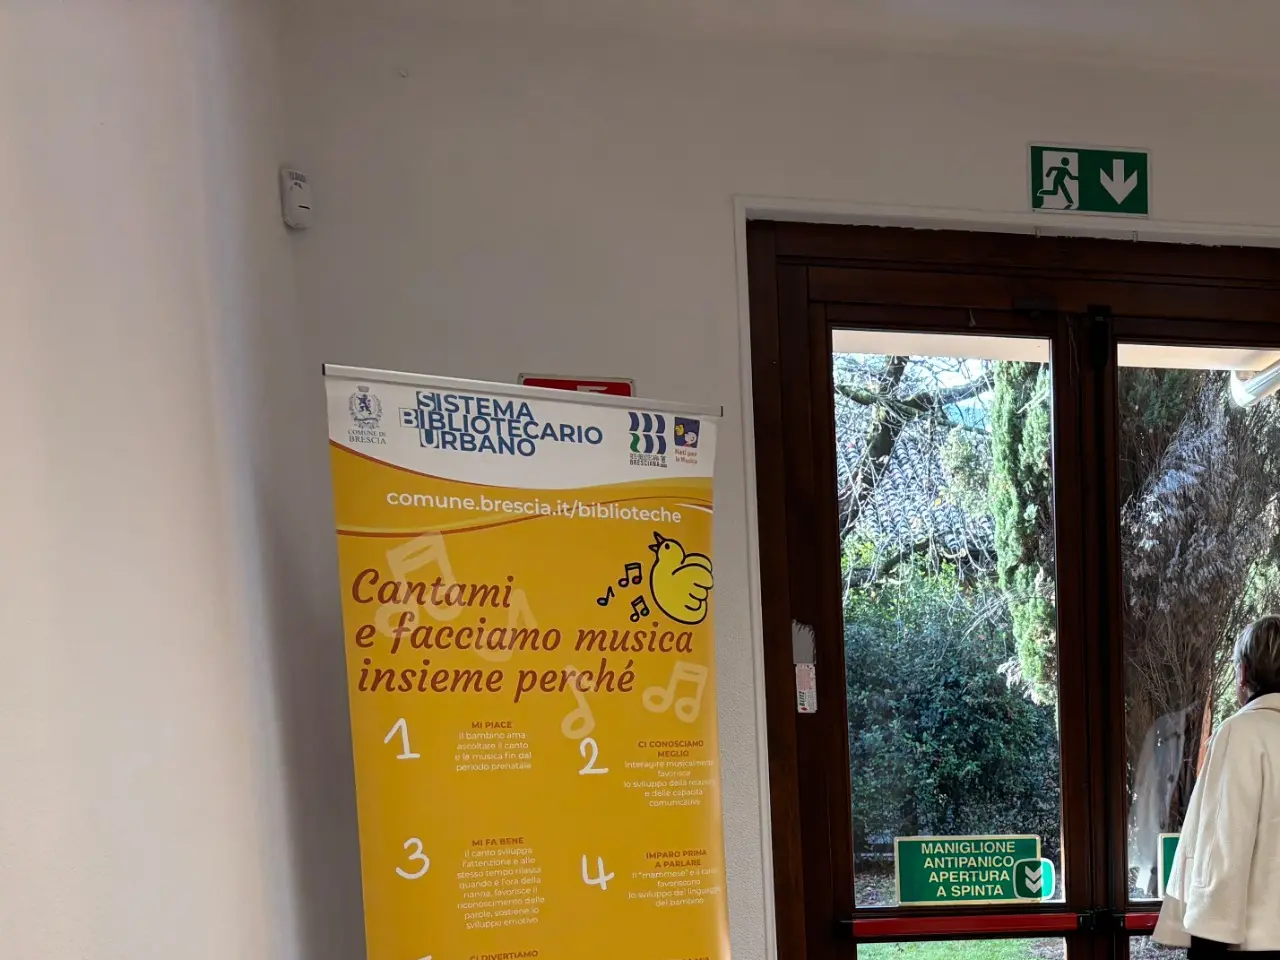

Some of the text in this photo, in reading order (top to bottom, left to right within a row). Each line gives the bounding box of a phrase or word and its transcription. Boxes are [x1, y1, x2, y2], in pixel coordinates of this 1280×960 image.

[416, 391, 534, 421] SISTEMA
[349, 436, 387, 444] BRESCIA
[399, 407, 603, 445] BIBLIOTECARIO
[420, 428, 536, 457] URBANO
[387, 490, 681, 522] comune.brescia.it/biblioteche
[352, 569, 513, 608] Cantami
[356, 612, 693, 654] e facciamo musica
[359, 658, 634, 702] insieme perché
[384, 718, 420, 759] 1
[649, 740, 703, 748] CONOSCIAMO
[579, 737, 608, 775] 2
[500, 837, 524, 845] BENE
[921, 841, 1016, 855] MANIGLIONE
[396, 837, 430, 879] 3
[581, 854, 614, 890] 4
[664, 859, 702, 868] PARLARE
[924, 855, 1014, 868] ANTIPANICO
[928, 869, 1010, 883] APERTURA
[937, 884, 1003, 897] A SPINTA
